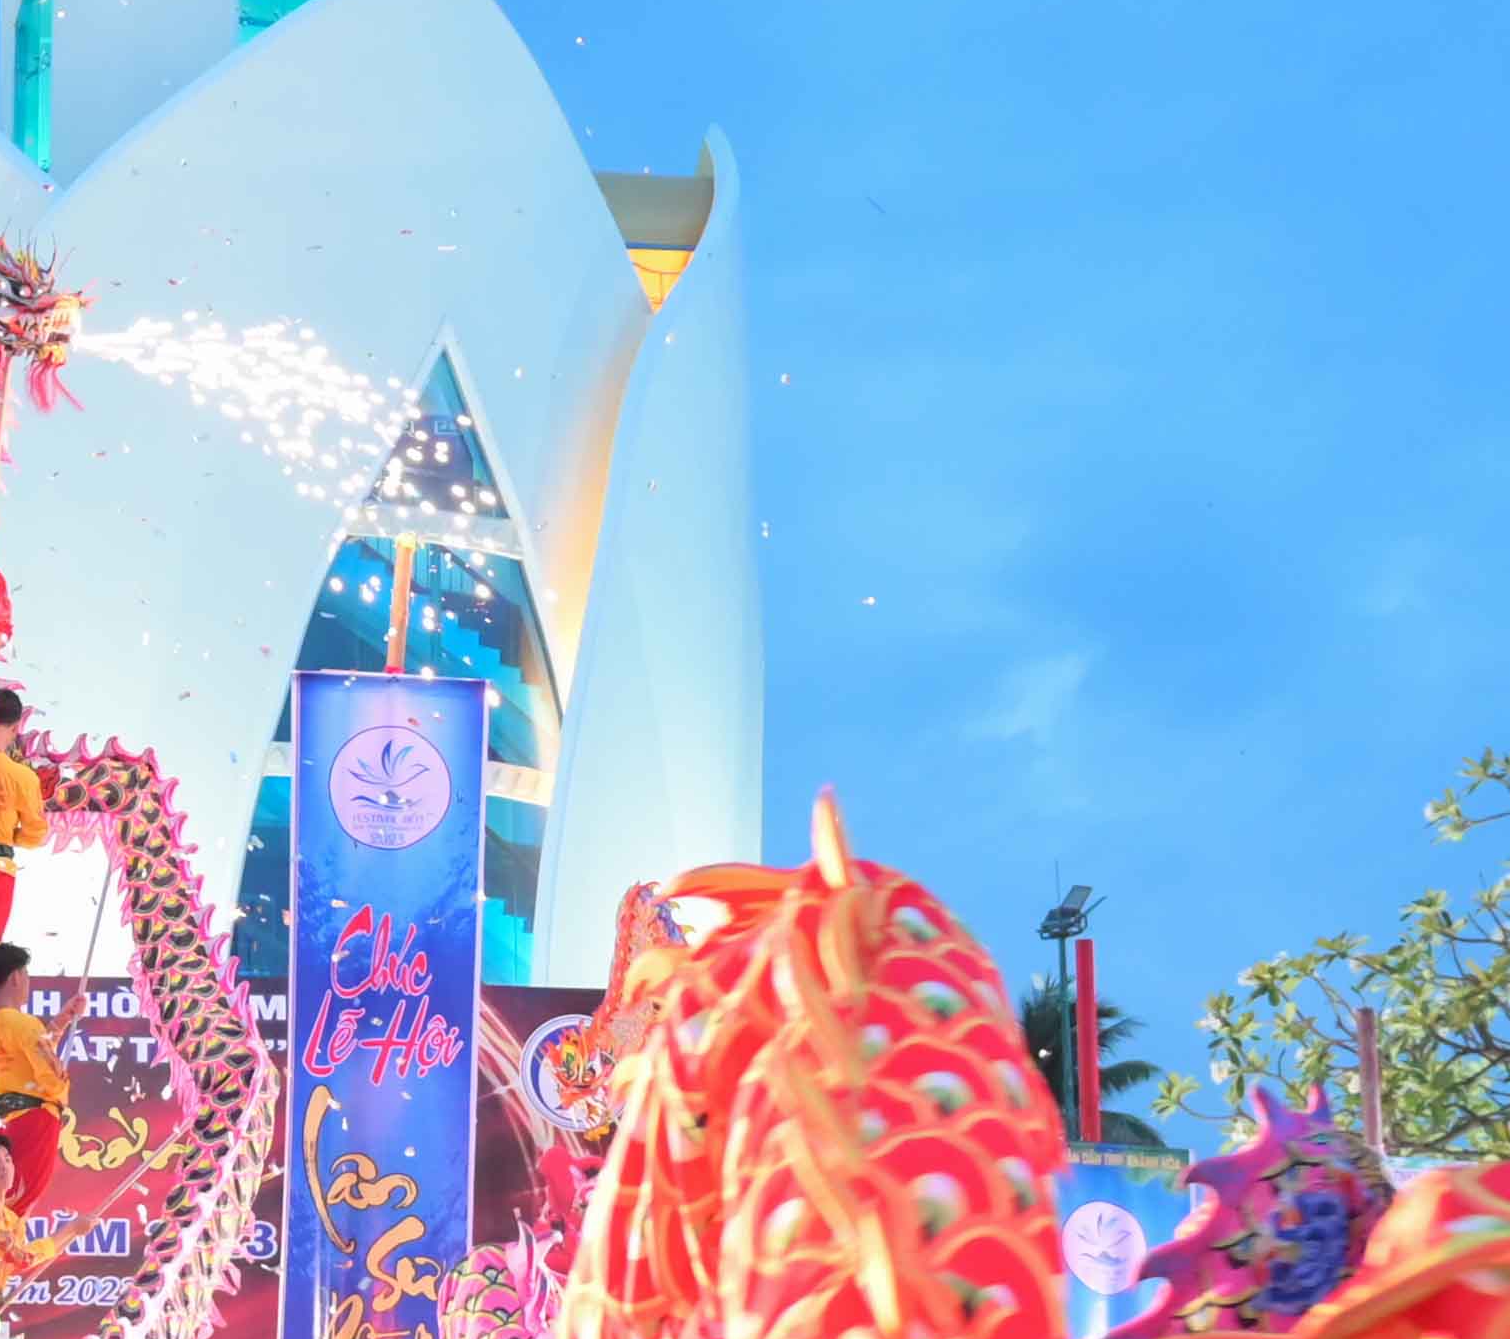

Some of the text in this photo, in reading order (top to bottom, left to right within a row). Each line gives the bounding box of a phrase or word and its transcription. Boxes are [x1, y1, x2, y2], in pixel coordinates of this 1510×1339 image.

[330, 903, 432, 999] Chúc
[84, 986, 140, 1018] HÒ
[302, 989, 464, 1086] Lễ Hội
[303, 1085, 419, 1254] Lân
[366, 1216, 442, 1312] Sư
